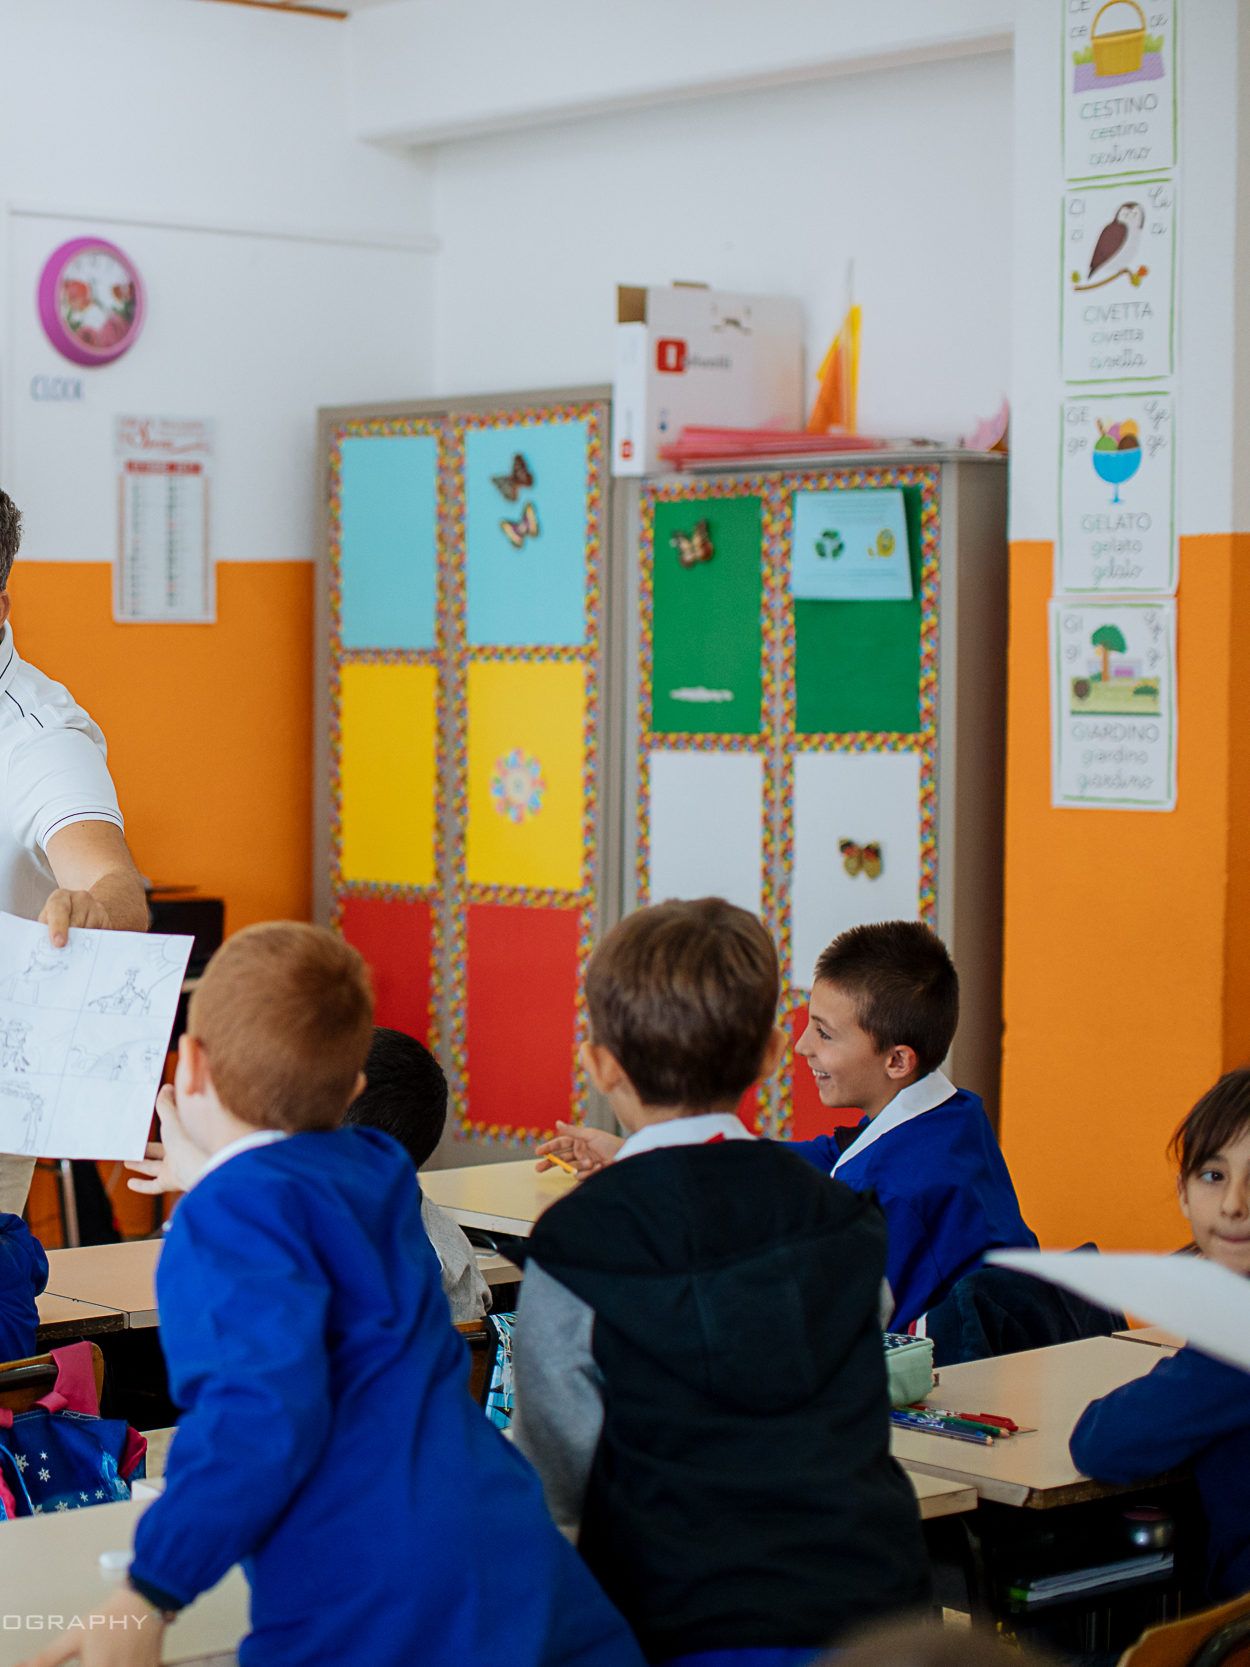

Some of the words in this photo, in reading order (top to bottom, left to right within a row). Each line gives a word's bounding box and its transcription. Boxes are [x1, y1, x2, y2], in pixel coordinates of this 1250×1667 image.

[1080, 93, 1159, 120] CESTINO
[1090, 121, 1148, 140] cestino
[1083, 302, 1154, 324] CIVETTA
[1066, 406, 1090, 423] GE
[1081, 512, 1152, 533] GELATO
[1091, 537, 1143, 558] gelato
[1070, 722, 1161, 743] GIARDINO
